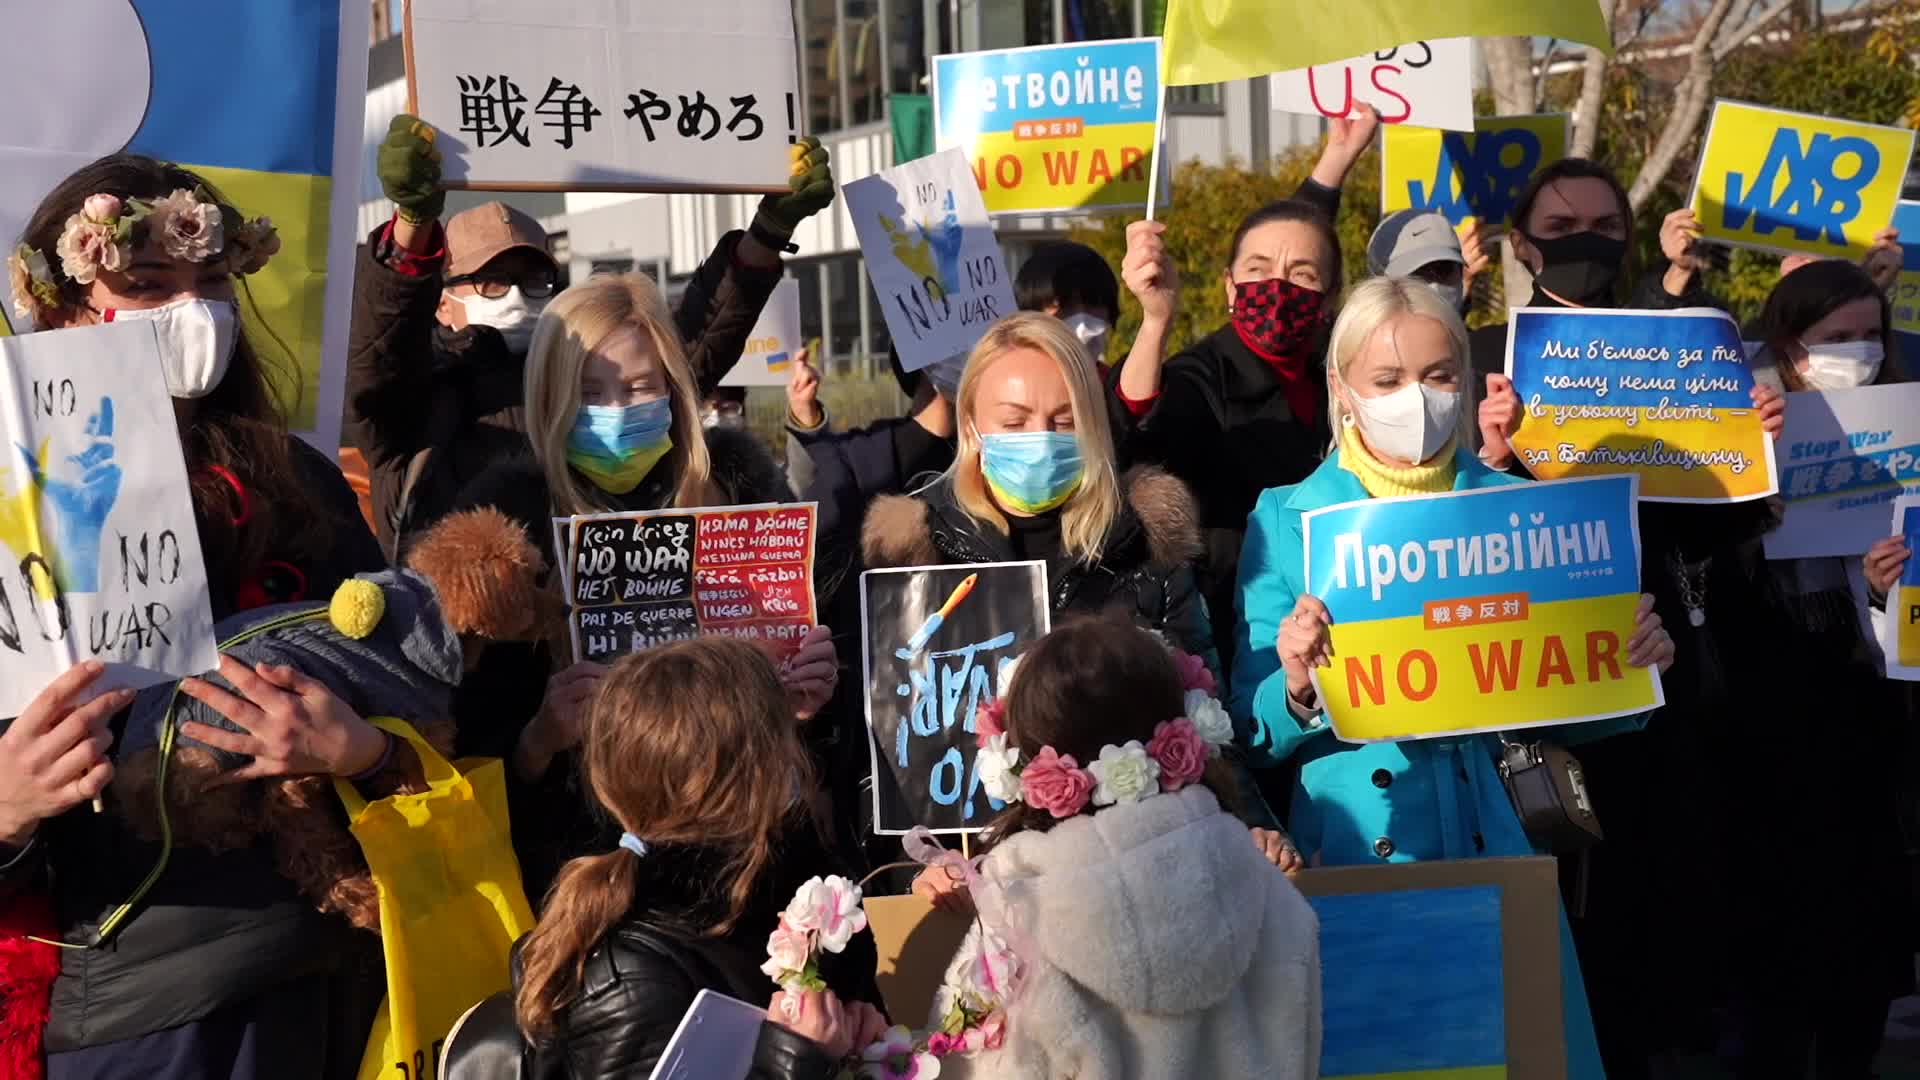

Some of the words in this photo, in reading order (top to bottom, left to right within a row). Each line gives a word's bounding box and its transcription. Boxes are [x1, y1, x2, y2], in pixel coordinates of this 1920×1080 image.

[1308, 64, 1411, 124] US
[1043, 146, 1145, 186] WAR
[1755, 128, 1881, 200] NO
[916, 182, 937, 205] NO
[1722, 171, 1863, 246] WAR
[966, 255, 997, 291] NO
[894, 275, 951, 341] NO
[959, 294, 1000, 326] WAR
[1541, 339, 1580, 359] Ми
[1676, 346, 1703, 369] за
[32, 378, 77, 422] NO
[1543, 375, 1609, 398] чому
[1619, 375, 1676, 391] нема
[1684, 374, 1740, 394] ціни
[1529, 393, 1548, 417] в
[1553, 404, 1638, 427] усьому
[1525, 447, 1550, 466] за
[116, 528, 183, 594] NO
[576, 546, 617, 577] NO
[625, 546, 691, 574] WAR
[1334, 511, 1611, 601] Противійни
[90, 602, 173, 656] WAR
[612, 611, 636, 626] DE
[640, 607, 695, 624] GUERRE
[1431, 599, 1521, 624] 戦争反対
[1345, 648, 1438, 708] NO
[1466, 630, 1625, 695] WAR
